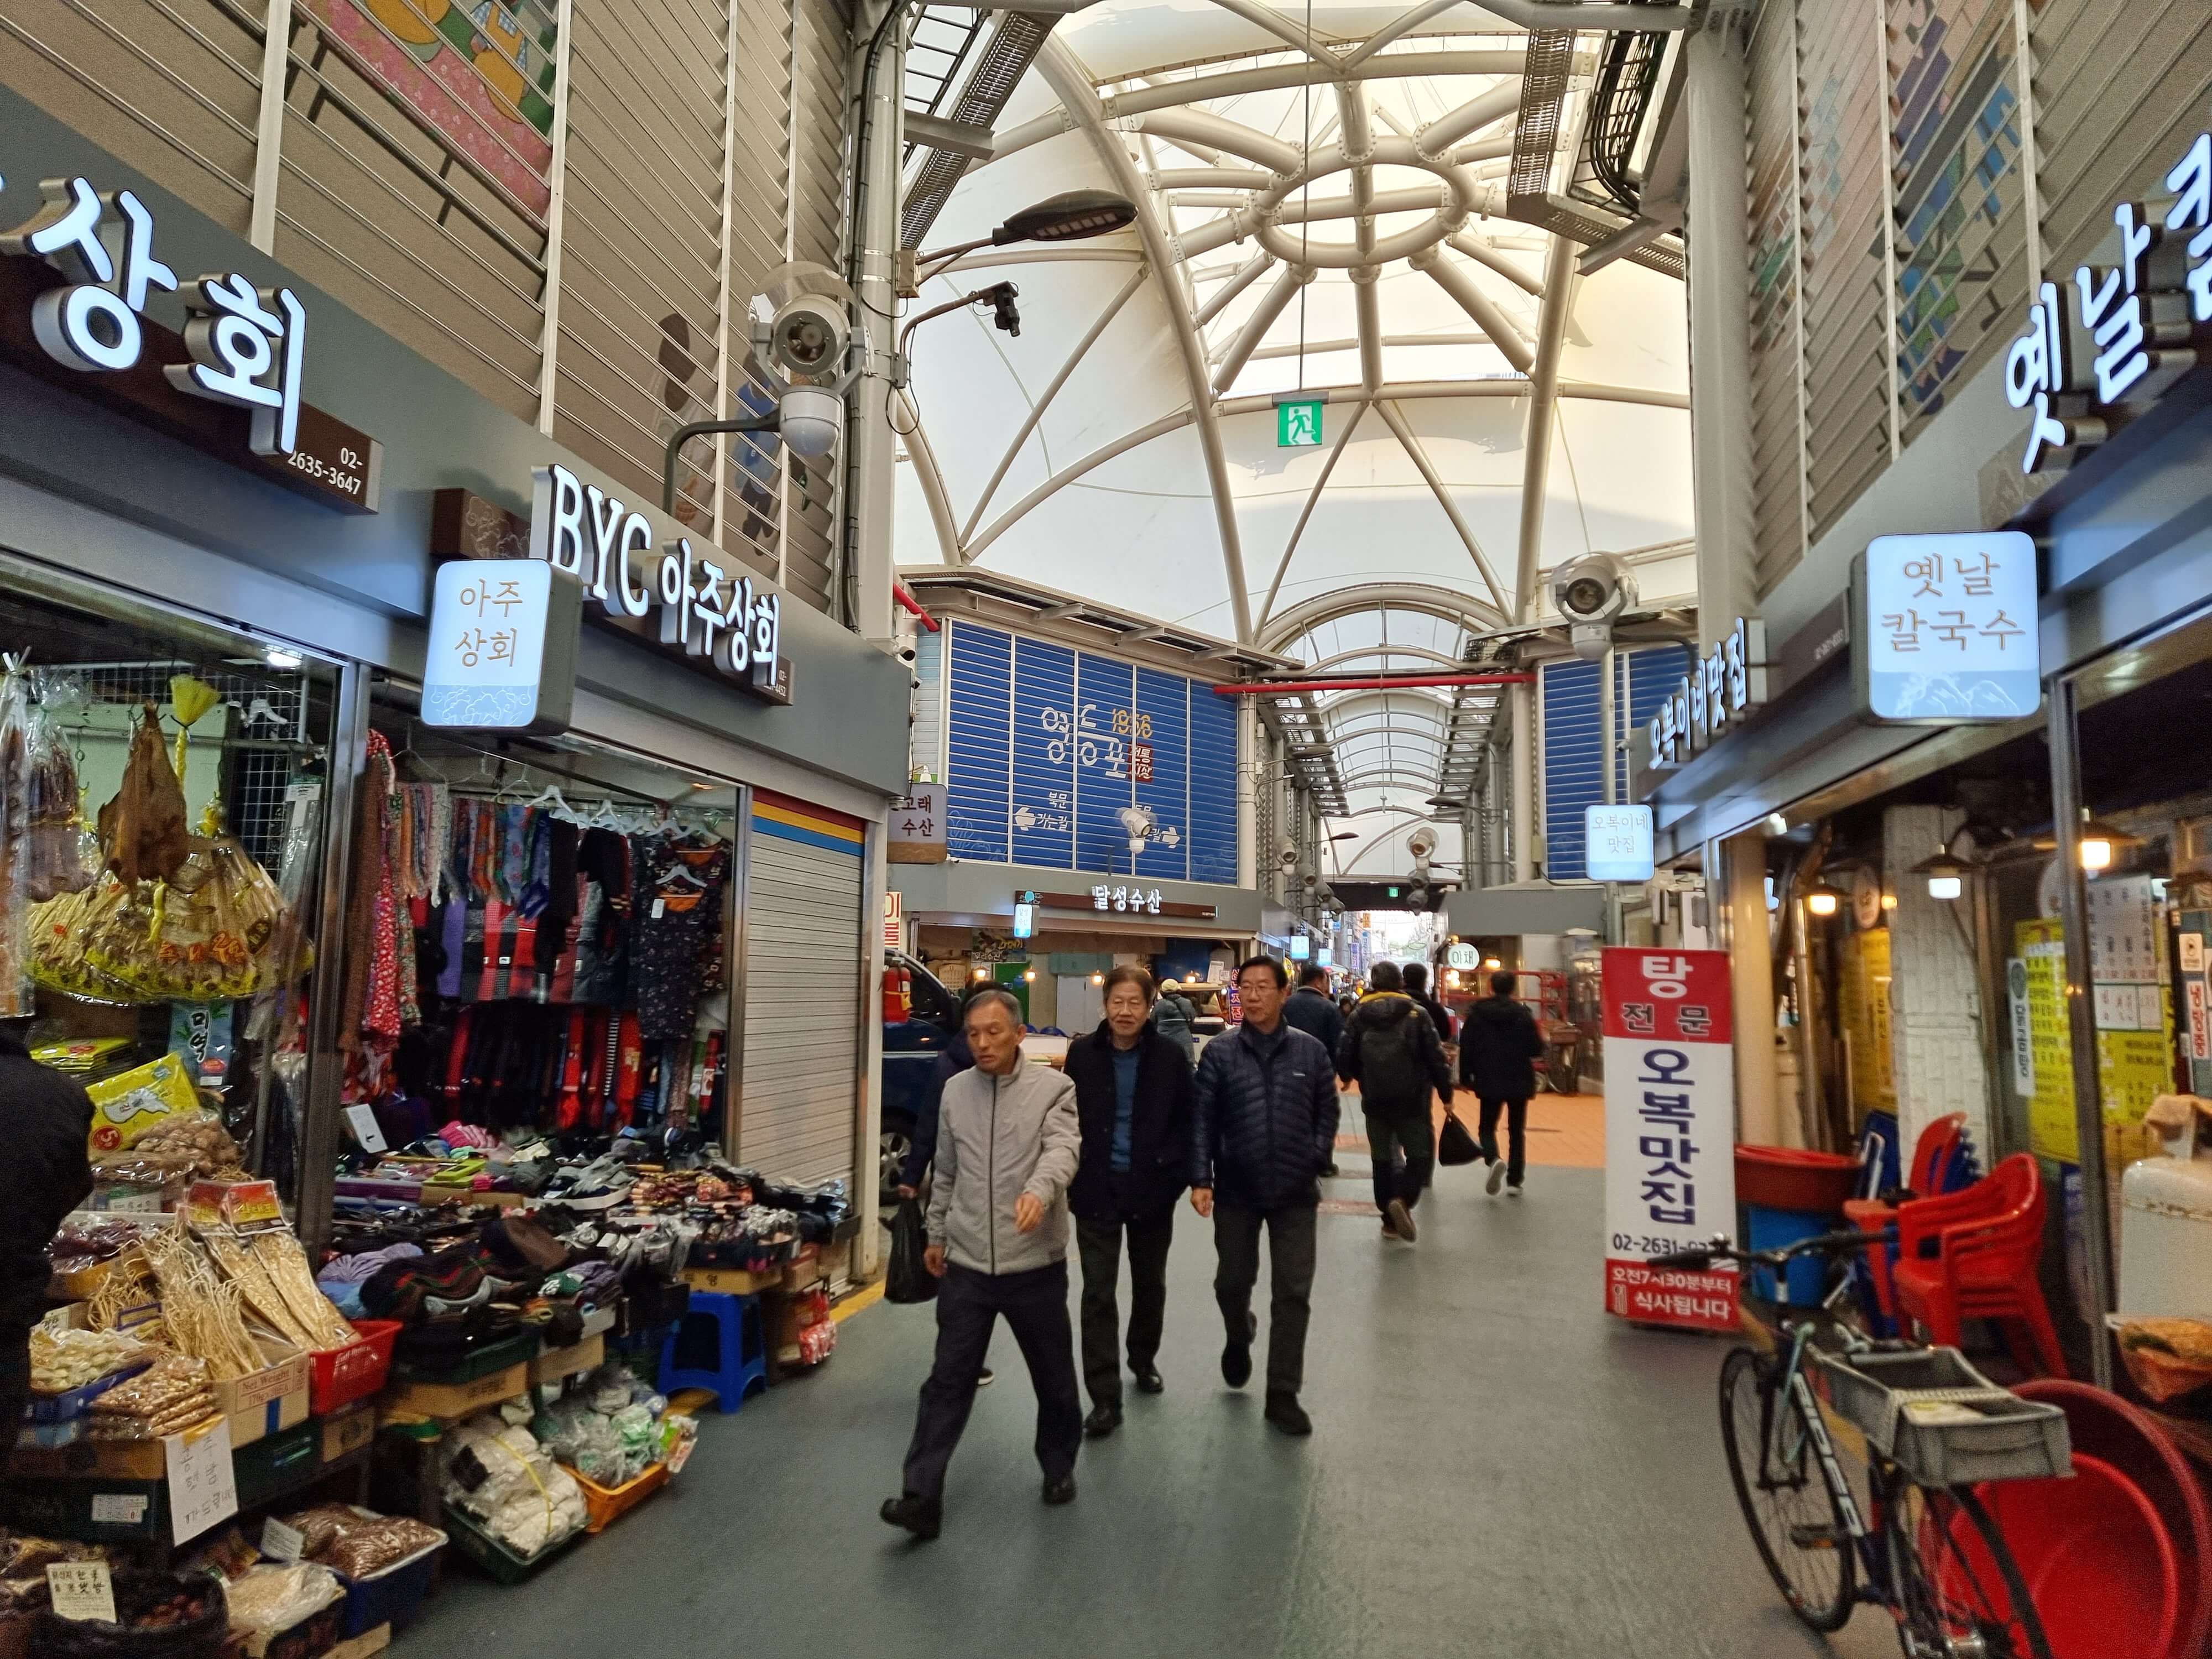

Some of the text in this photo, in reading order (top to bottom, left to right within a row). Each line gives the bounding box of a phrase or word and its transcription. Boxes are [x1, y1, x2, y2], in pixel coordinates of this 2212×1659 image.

[30, 176, 307, 455] 상회
[288, 451, 361, 494] 2635-3647
[340, 447, 363, 469] 02-
[554, 464, 780, 686] BYC 아주상회
[1904, 552, 2001, 598] 옛날
[460, 578, 523, 618] 아주
[454, 627, 518, 667] 상회
[1882, 608, 2026, 653] 칼국수
[1646, 615, 1746, 770] 오복이네맛집
[1040, 703, 1126, 779] 영등포
[1112, 707, 1153, 739] 1956
[901, 794, 931, 813] 고래
[1048, 791, 1068, 810] 북문
[901, 818, 935, 837] 수산
[1036, 812, 1068, 831] 가는길
[1592, 812, 1648, 832] 오복이네
[1608, 835, 1635, 854] 맛집
[1091, 885, 1162, 914] 달성수산
[1641, 956, 1694, 999] 탕
[190, 1011, 211, 1063] 미역
[1637, 1048, 1700, 1226] 오복맛집
